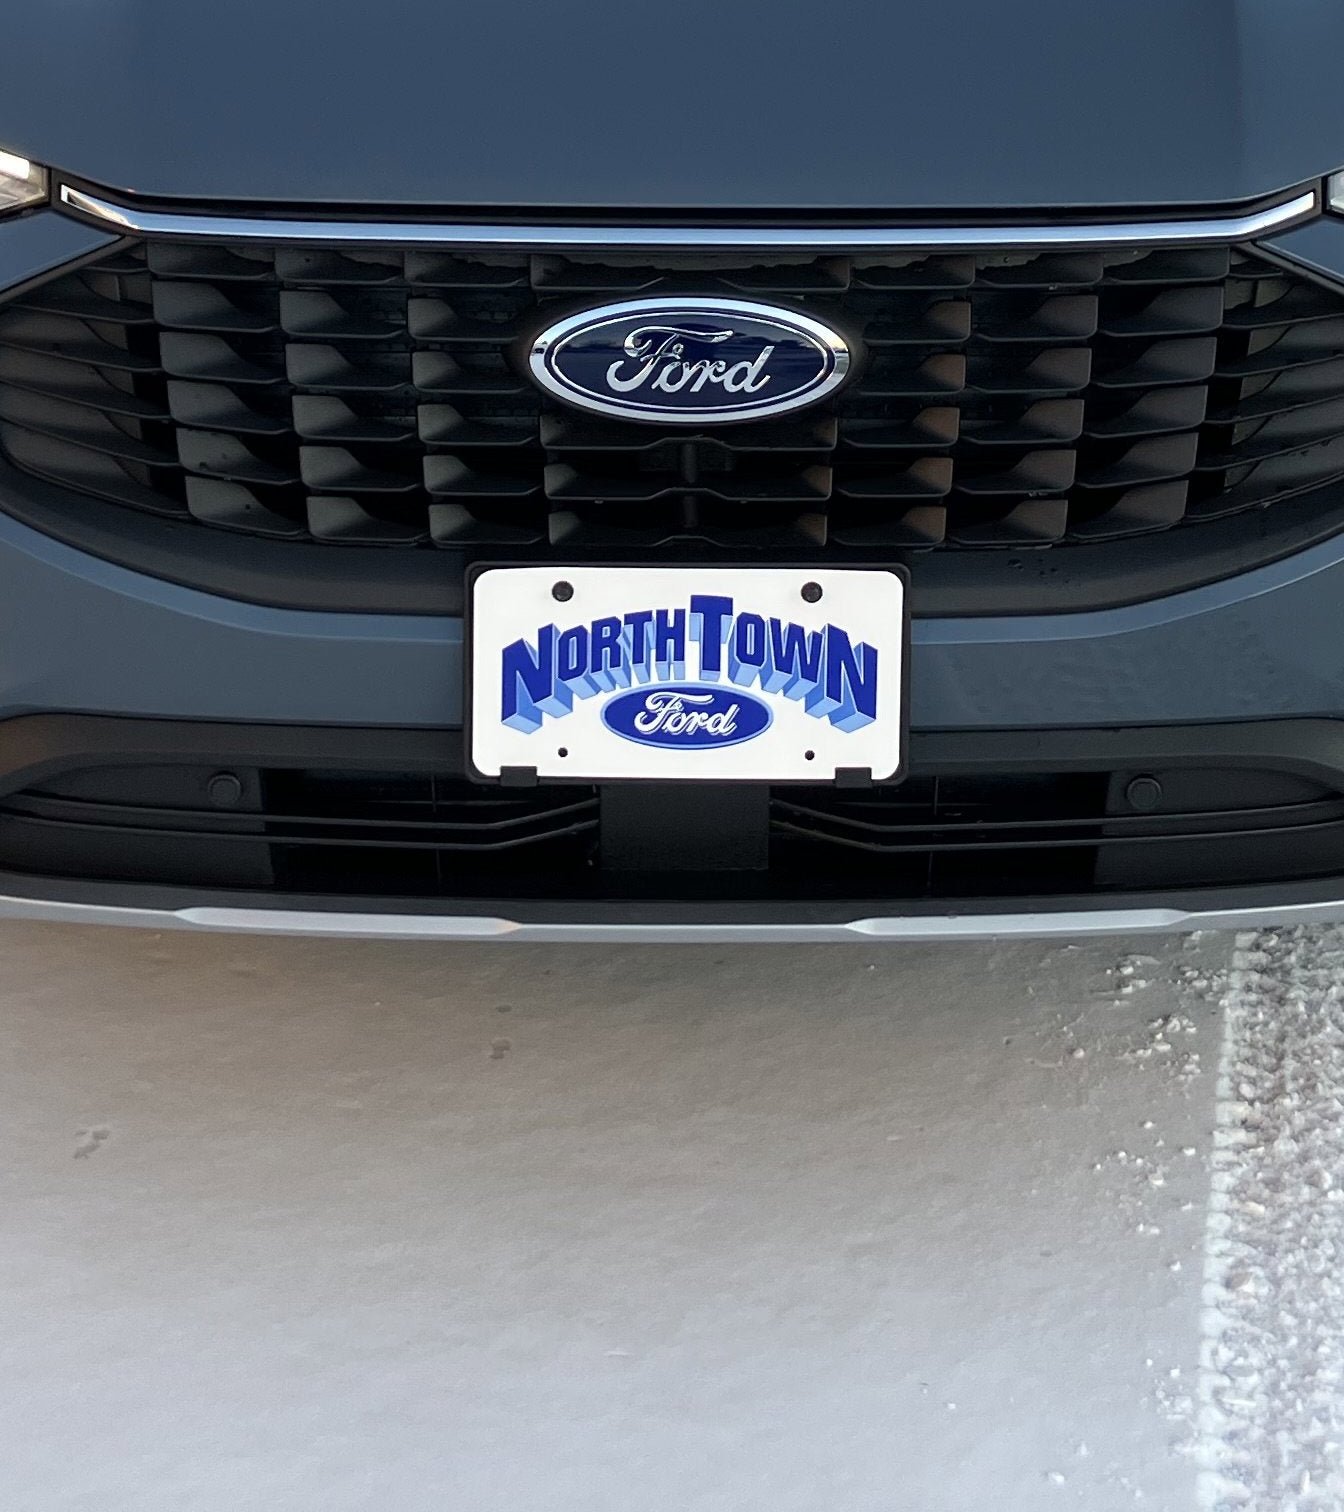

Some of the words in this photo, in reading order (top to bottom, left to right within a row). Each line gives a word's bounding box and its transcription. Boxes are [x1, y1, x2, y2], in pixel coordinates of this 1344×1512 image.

[606, 325, 775, 394] Ford
[501, 595, 878, 728] NORTHTOWN
[633, 691, 741, 737] Ford
